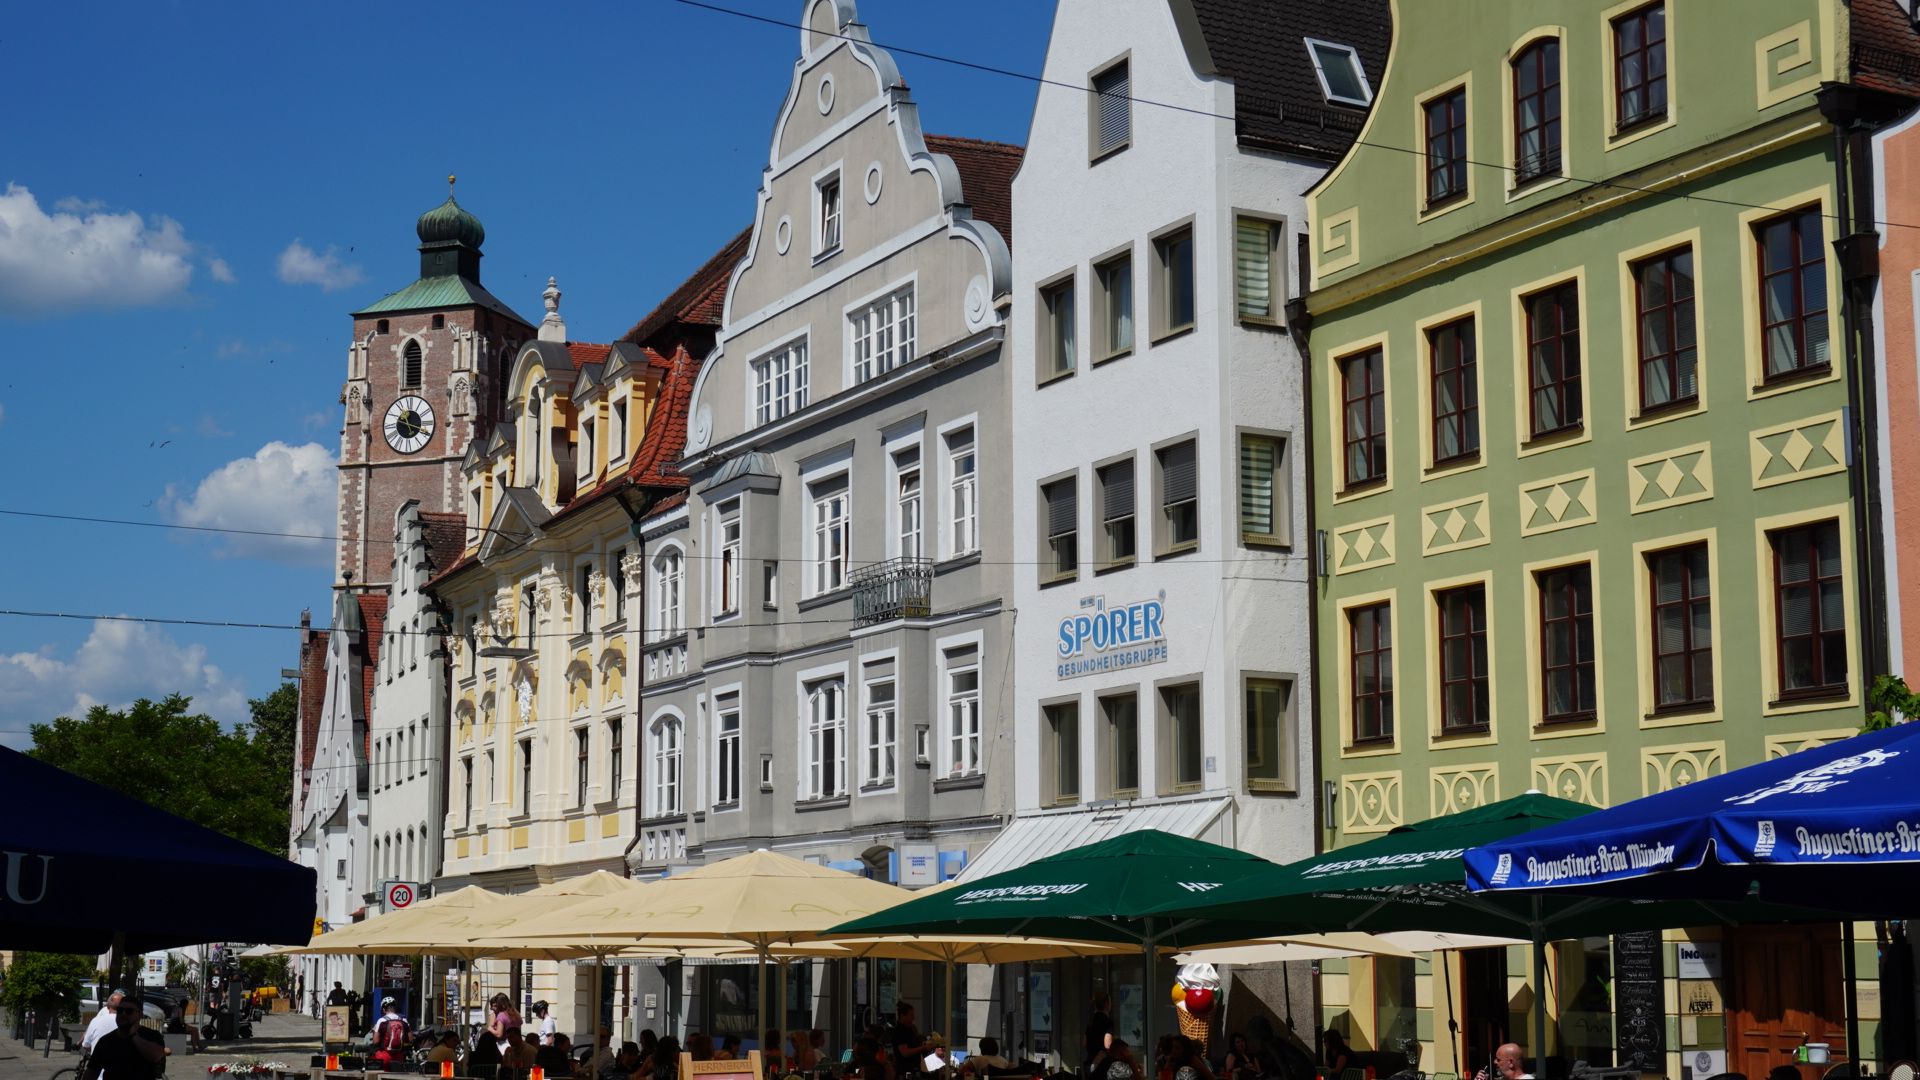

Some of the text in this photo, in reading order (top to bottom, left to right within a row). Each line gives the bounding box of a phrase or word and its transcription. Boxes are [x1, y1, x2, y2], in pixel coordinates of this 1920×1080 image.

[1058, 598, 1162, 656] SPÖRER
[1057, 646, 1167, 677] GESUNDHEITSGRUPPE
[0, 850, 55, 904] U
[395, 890, 408, 902] 20
